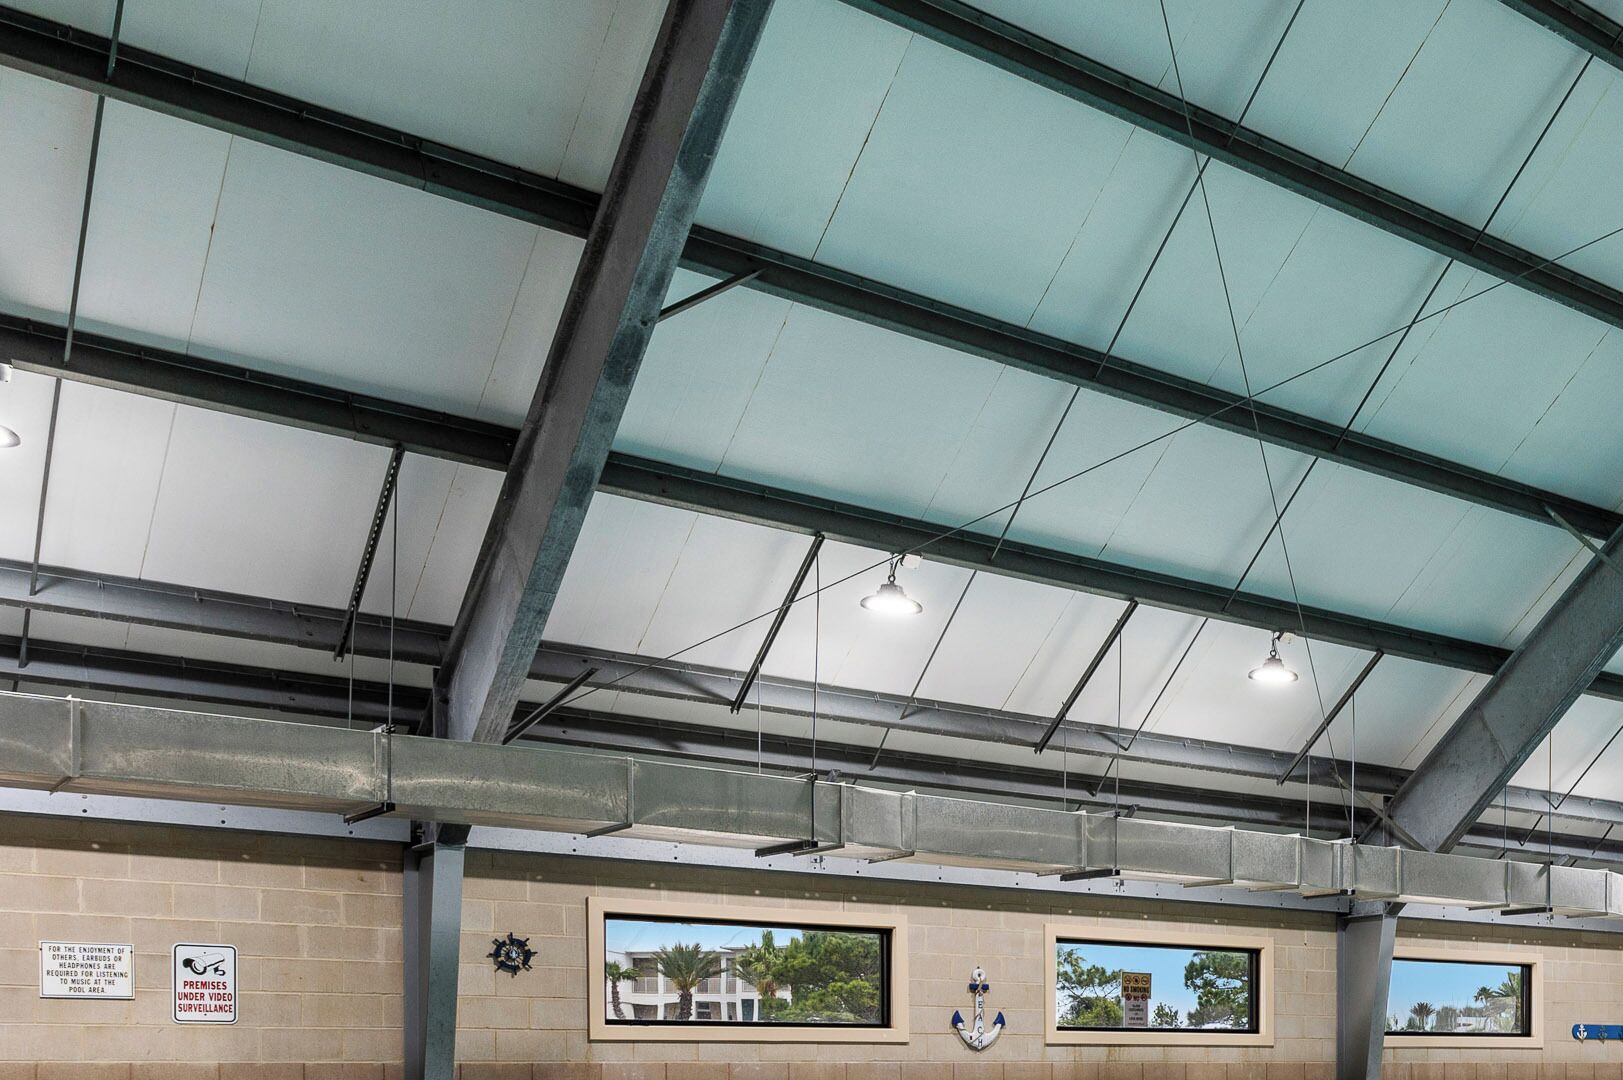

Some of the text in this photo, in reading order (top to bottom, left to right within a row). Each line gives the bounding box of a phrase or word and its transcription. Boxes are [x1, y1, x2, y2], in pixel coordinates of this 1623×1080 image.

[183, 981, 227, 990] PREMISES
[178, 992, 233, 1002] UNDER VIDEO
[178, 1003, 233, 1013] SURVEILLANCE
